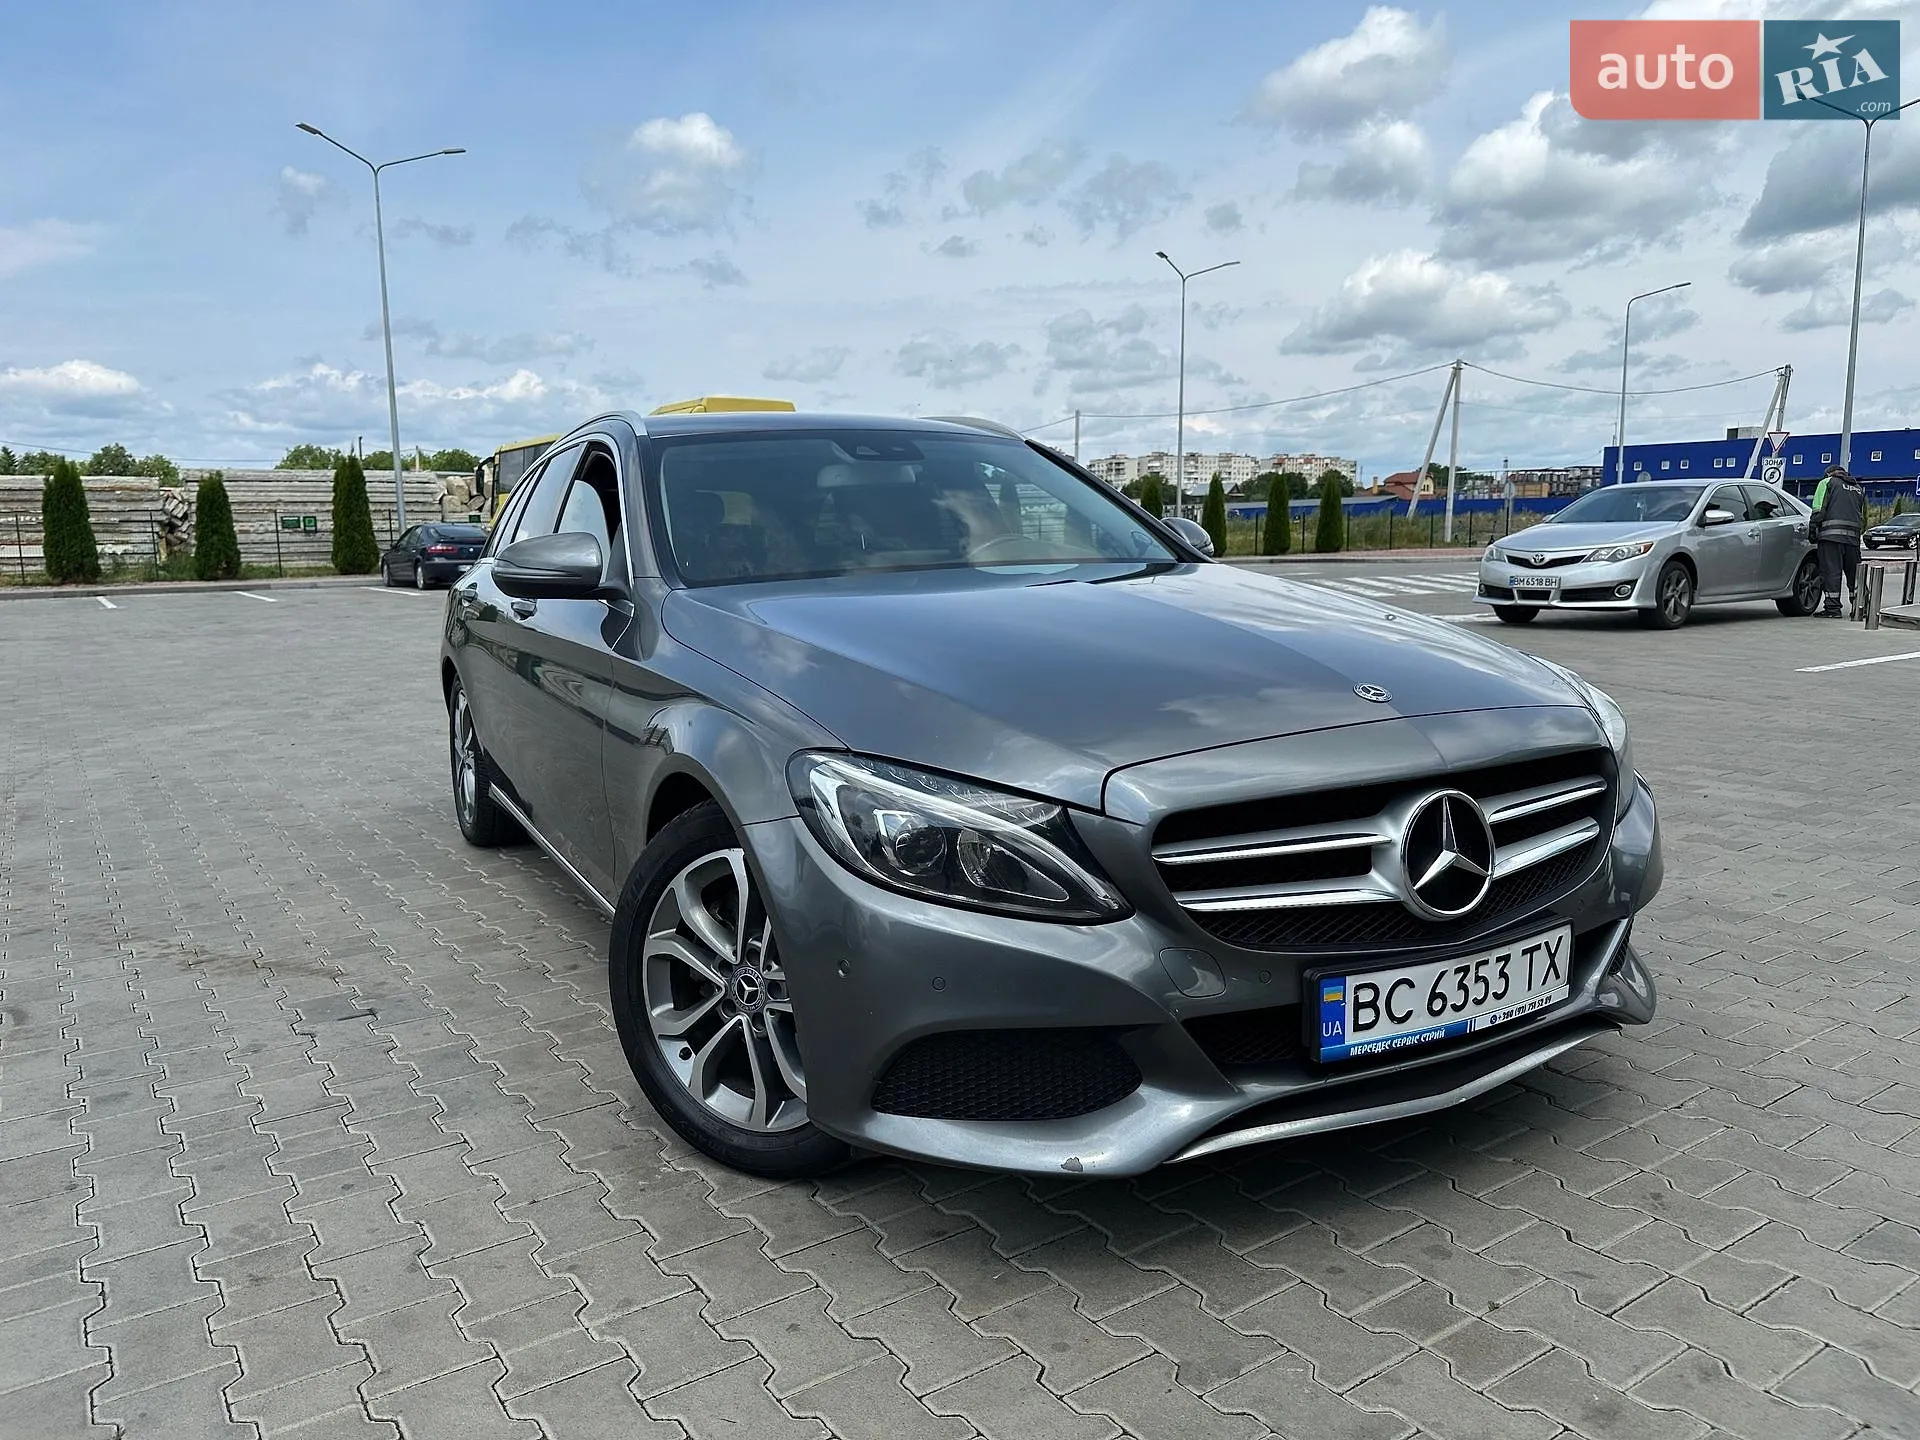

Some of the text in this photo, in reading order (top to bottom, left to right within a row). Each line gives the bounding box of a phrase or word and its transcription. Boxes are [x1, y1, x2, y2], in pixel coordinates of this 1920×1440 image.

[1769, 471, 1776, 480] 5
[1513, 577, 1525, 586] BM
[1545, 577, 1557, 586] BH
[1352, 935, 1563, 1033] BC 6353 TX
[1322, 1021, 1343, 1037] UA
[1350, 1028, 1446, 1056] МЕРСЕДЕС СЕРВІС СТРИЙ
